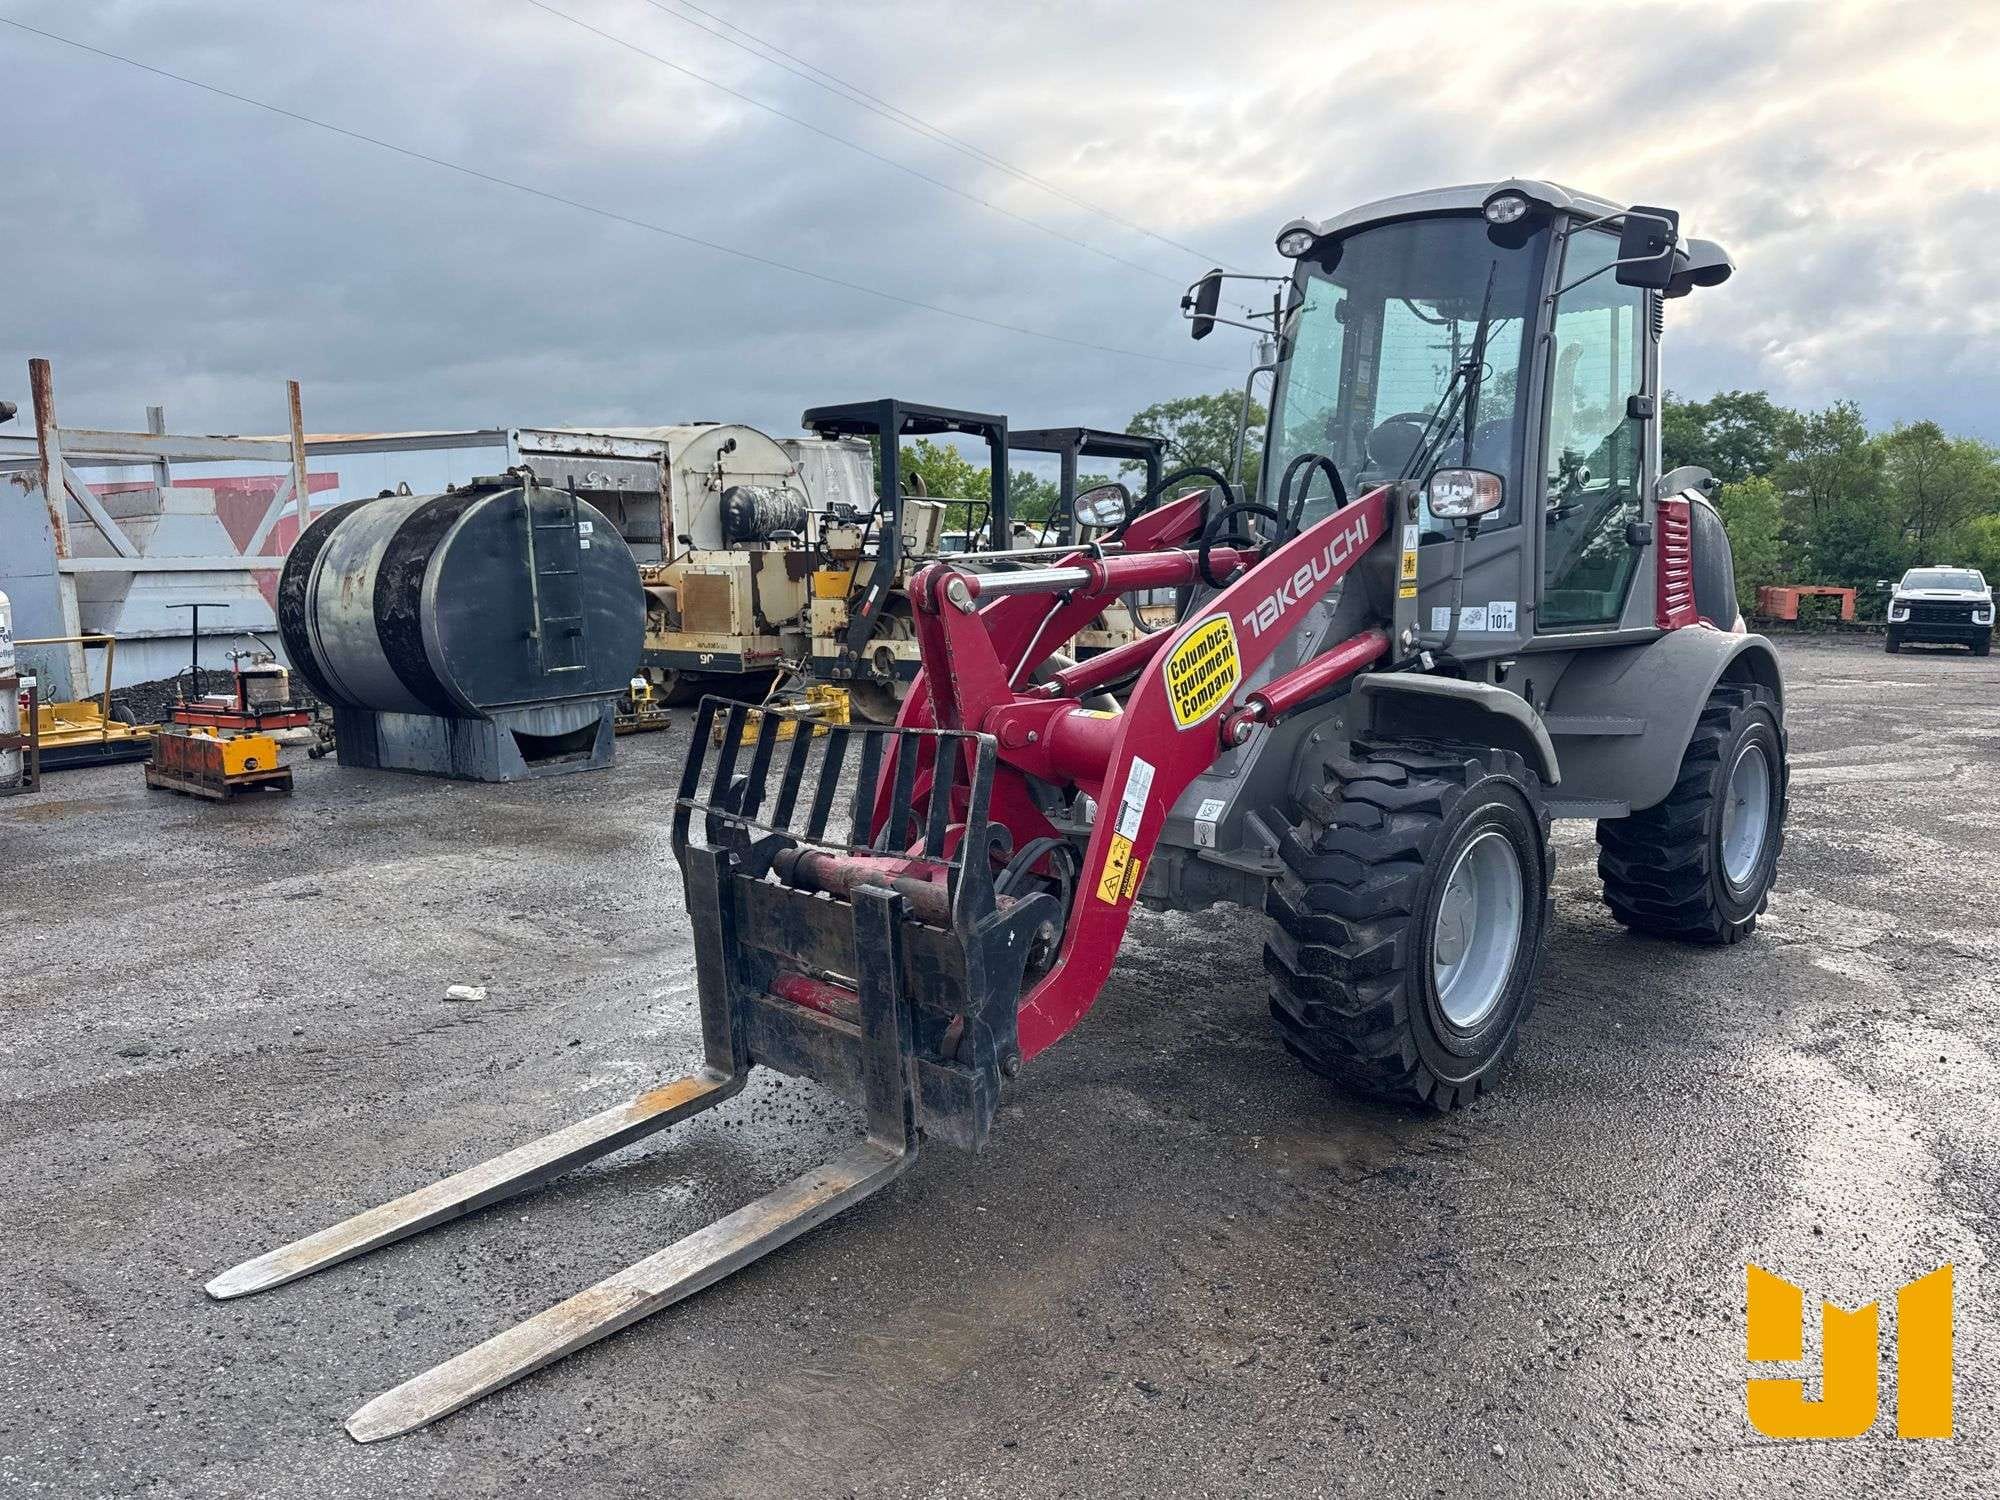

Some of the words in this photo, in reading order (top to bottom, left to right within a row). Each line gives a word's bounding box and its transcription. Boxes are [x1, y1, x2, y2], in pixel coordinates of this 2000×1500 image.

[1491, 614, 1507, 629] 101
[1170, 624, 1229, 681] Columbus
[1173, 640, 1234, 703] Equipment
[1181, 664, 1234, 718] Company
[1119, 857, 1135, 896] WARNING
